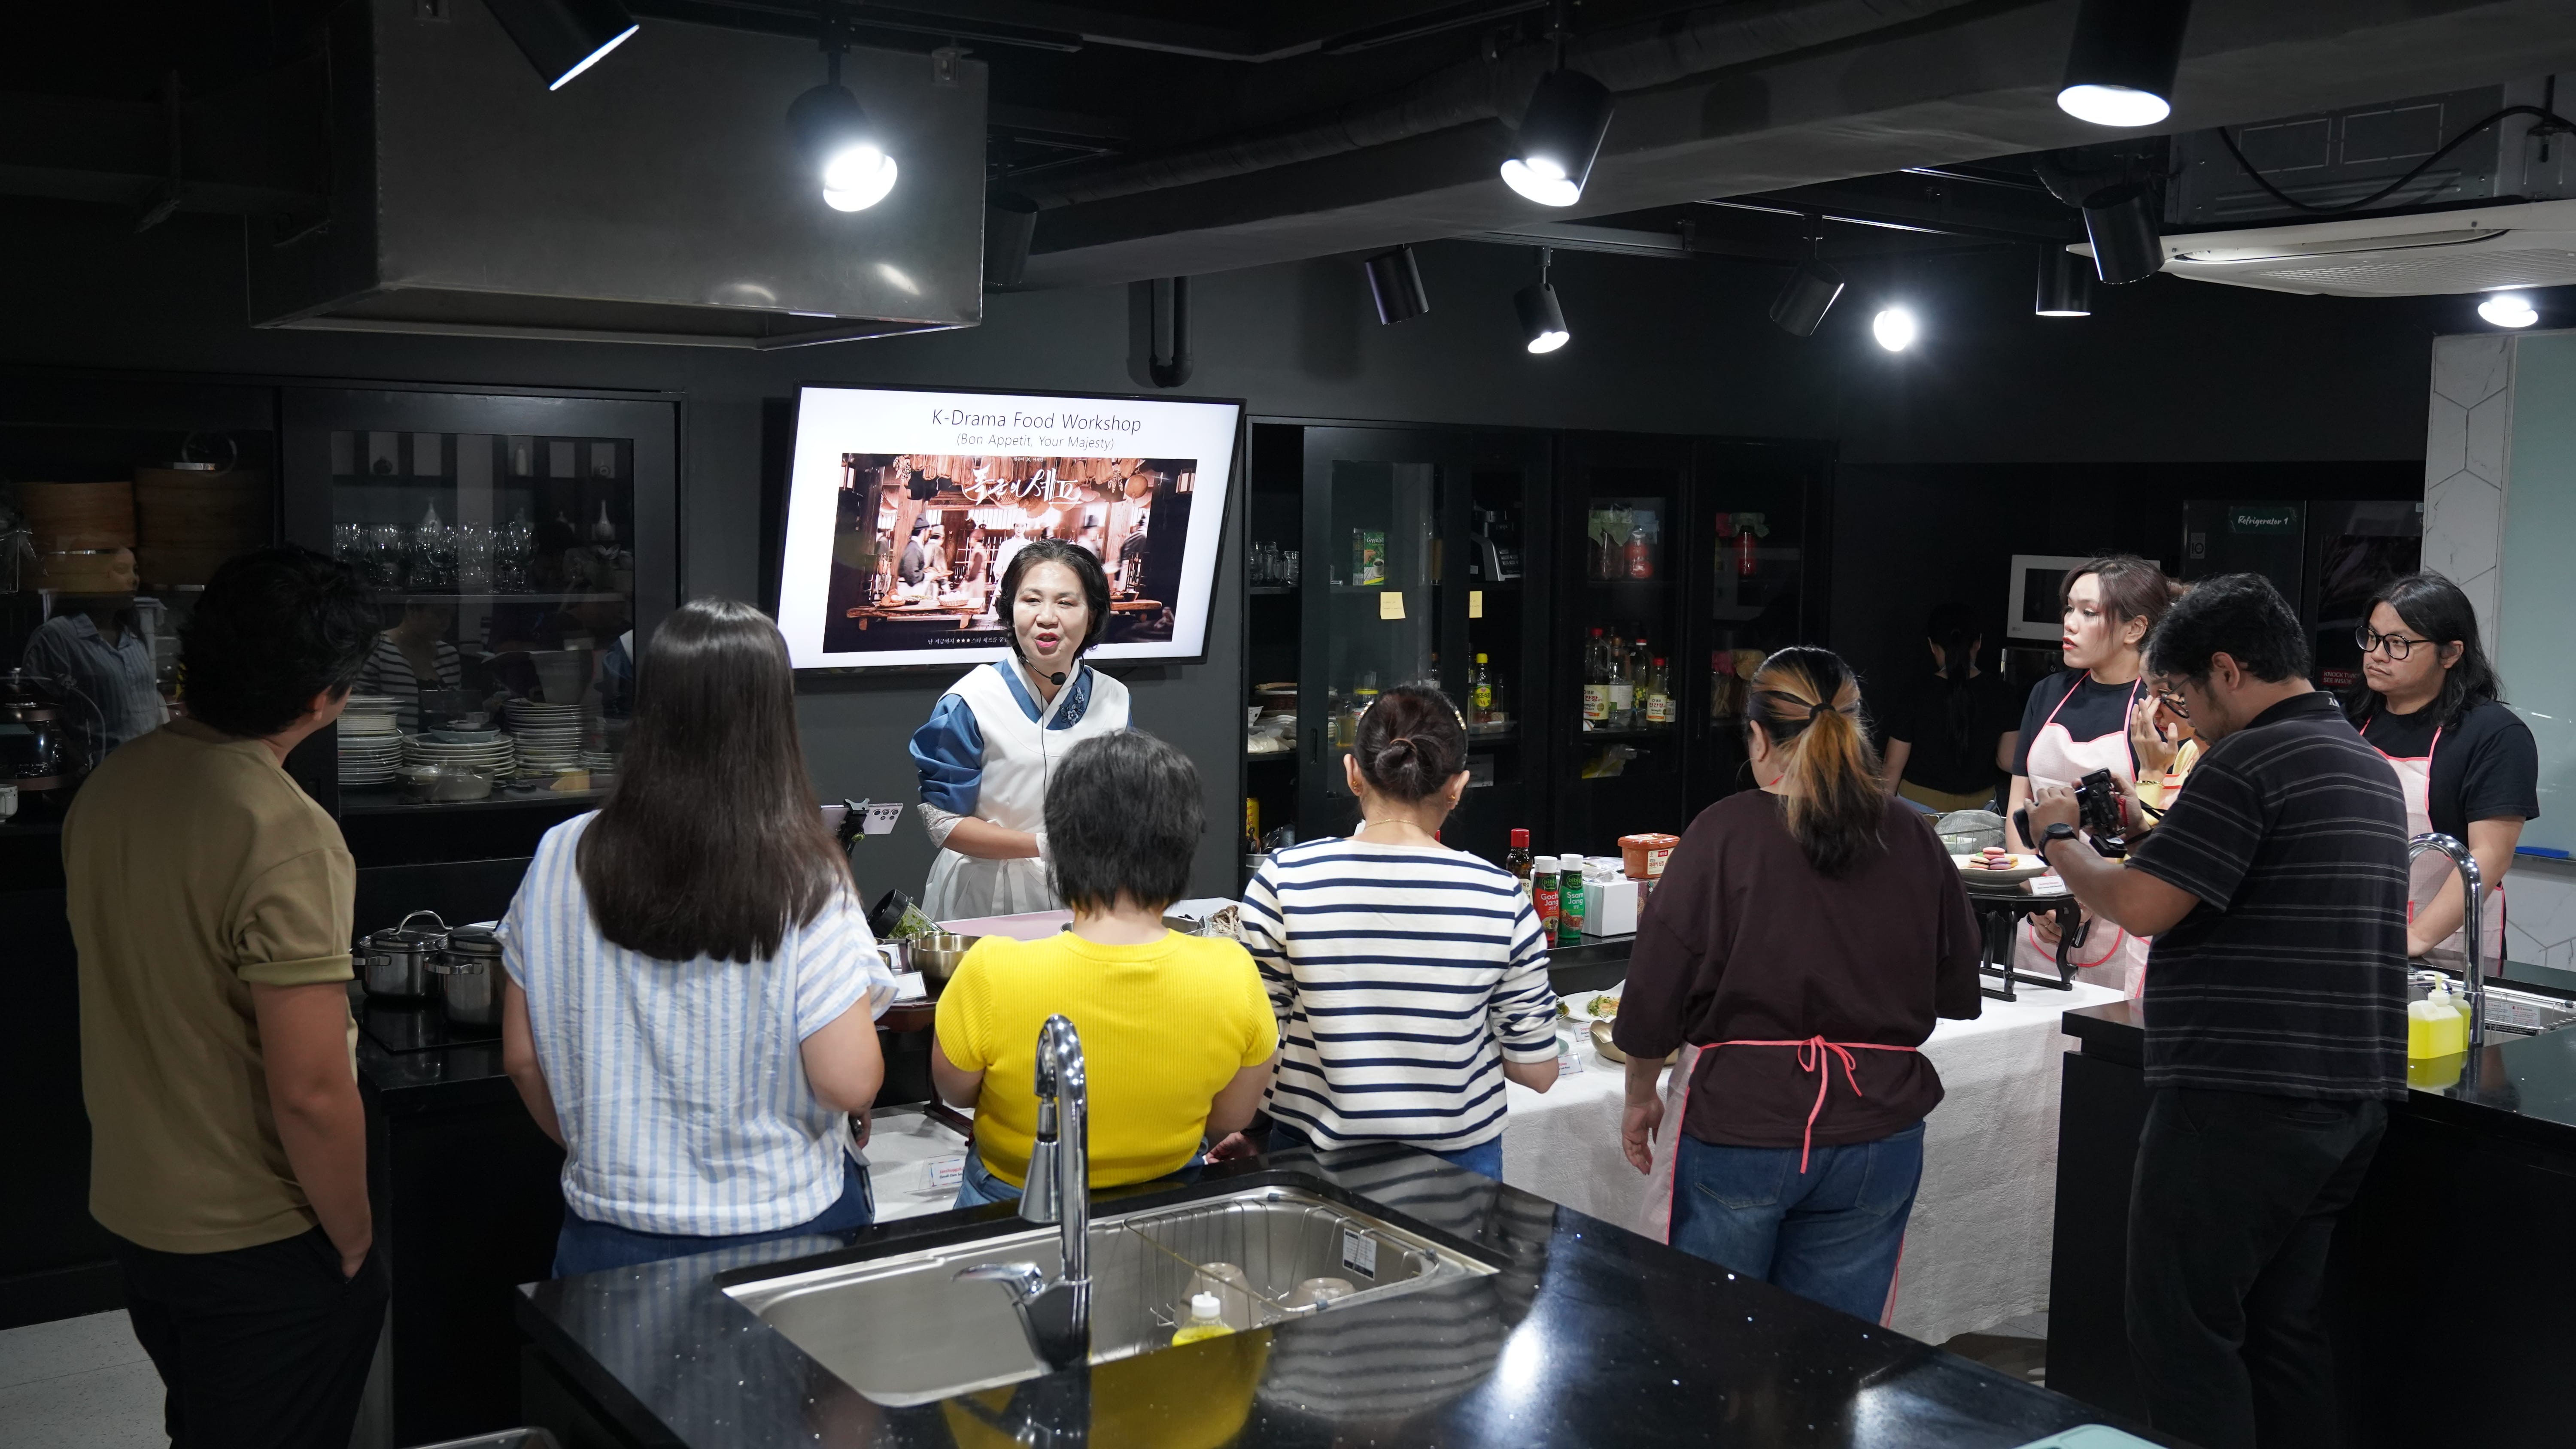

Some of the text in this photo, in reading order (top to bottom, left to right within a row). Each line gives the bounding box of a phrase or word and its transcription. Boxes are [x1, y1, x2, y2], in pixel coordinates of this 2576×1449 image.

[933, 409, 1141, 435] K-Drama Food Workshop
[957, 433, 1114, 451] (Bon Appetit, Your Majesty)
[2238, 515, 2282, 527] Refrigerator
[2191, 542, 2204, 555] 10
